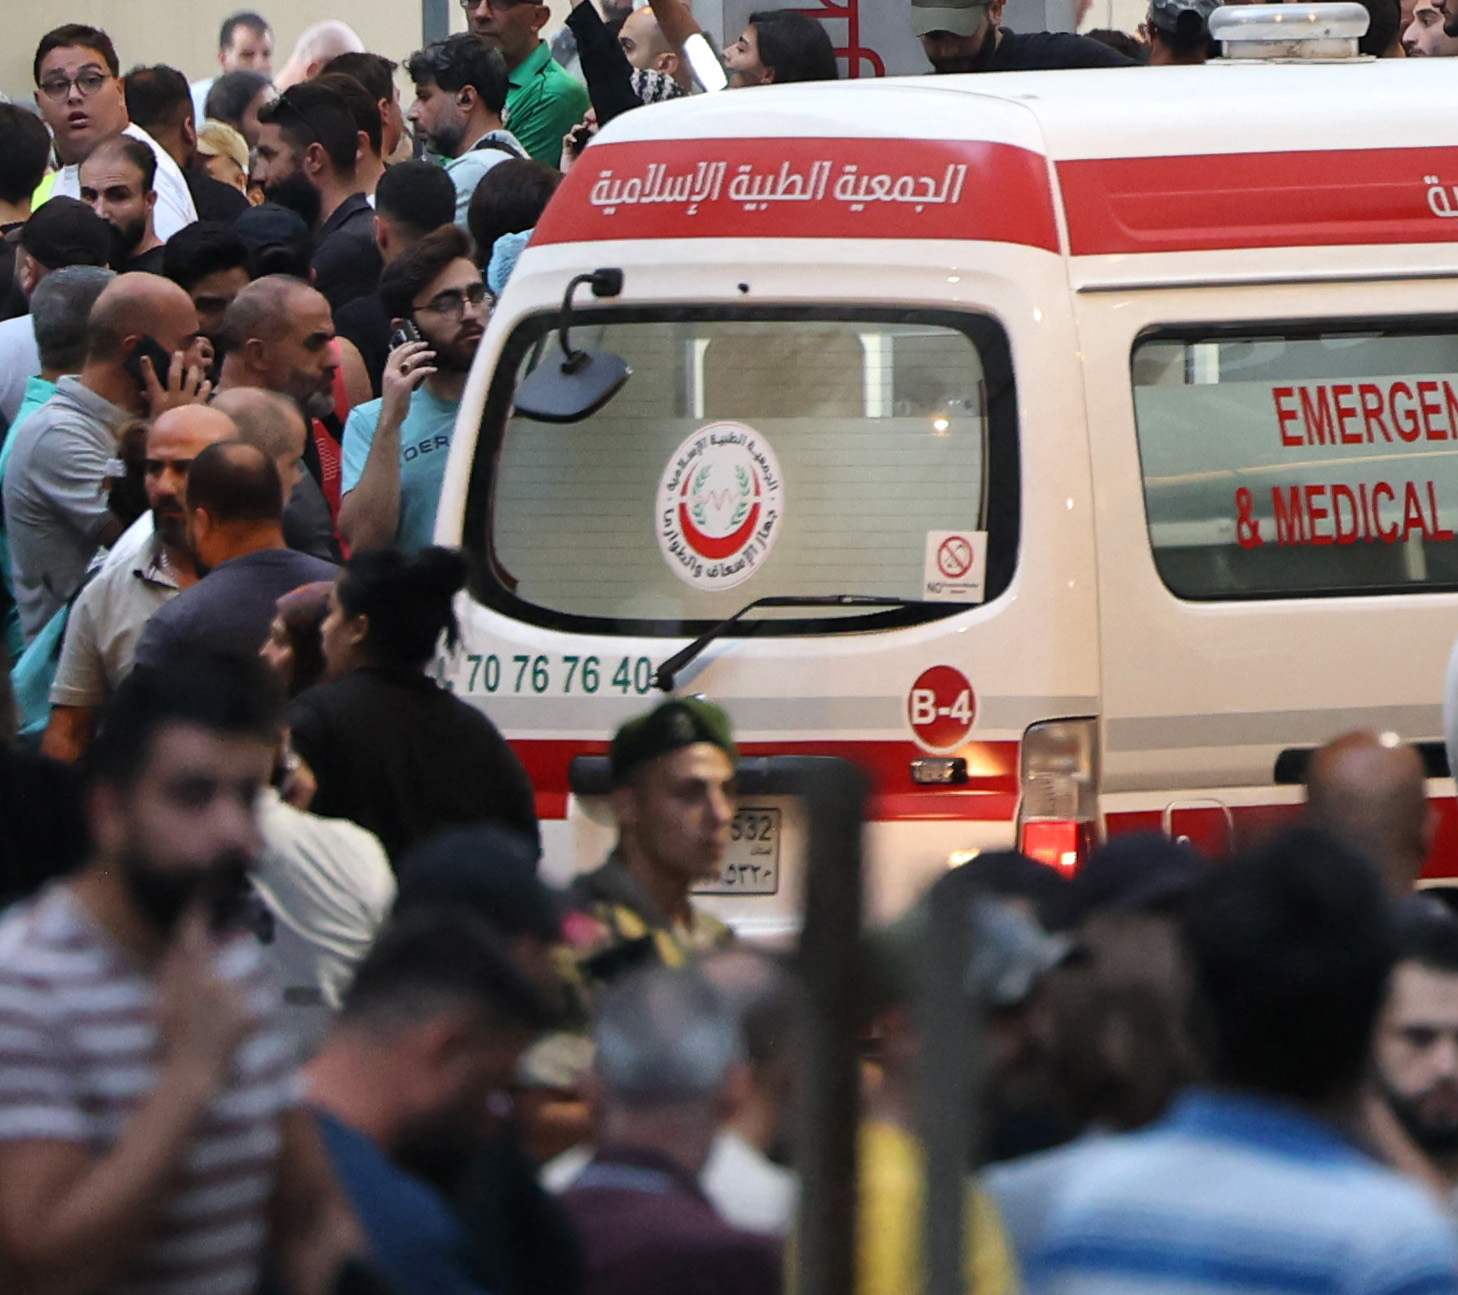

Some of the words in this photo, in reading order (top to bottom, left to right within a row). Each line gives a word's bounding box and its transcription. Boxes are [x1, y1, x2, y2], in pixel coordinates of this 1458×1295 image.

[590, 161, 727, 216] الإسلامية
[728, 160, 833, 212] الطبية
[834, 163, 968, 213] الجمعية
[1235, 486, 1264, 551] &
[1271, 479, 1455, 548] MEDICAL
[466, 654, 501, 693] 70
[513, 655, 550, 693] 76
[562, 655, 601, 694] 76
[611, 656, 652, 694] 40
[911, 688, 973, 725] B-4
